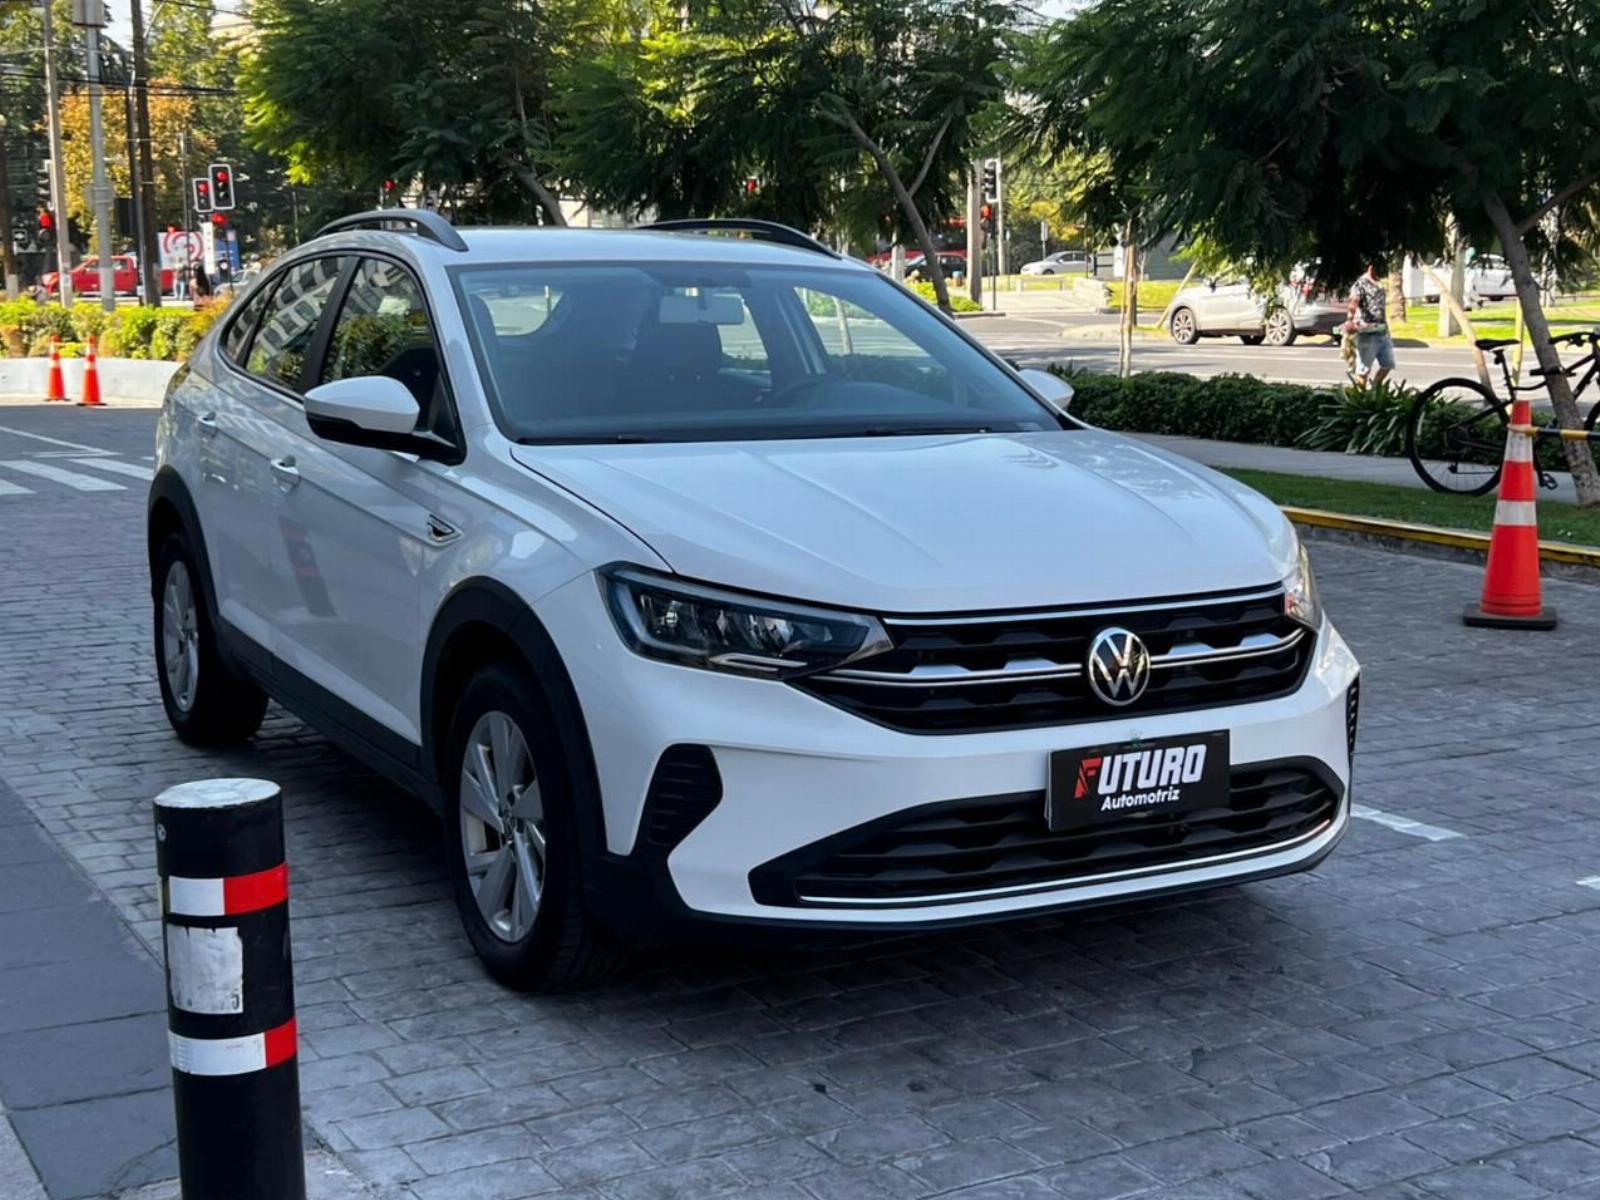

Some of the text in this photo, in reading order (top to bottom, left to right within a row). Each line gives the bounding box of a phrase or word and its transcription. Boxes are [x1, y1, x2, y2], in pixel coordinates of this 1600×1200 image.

[1092, 632, 1147, 700] VW
[1074, 744, 1207, 798] FUTURO
[1101, 788, 1180, 811] Automotriz
